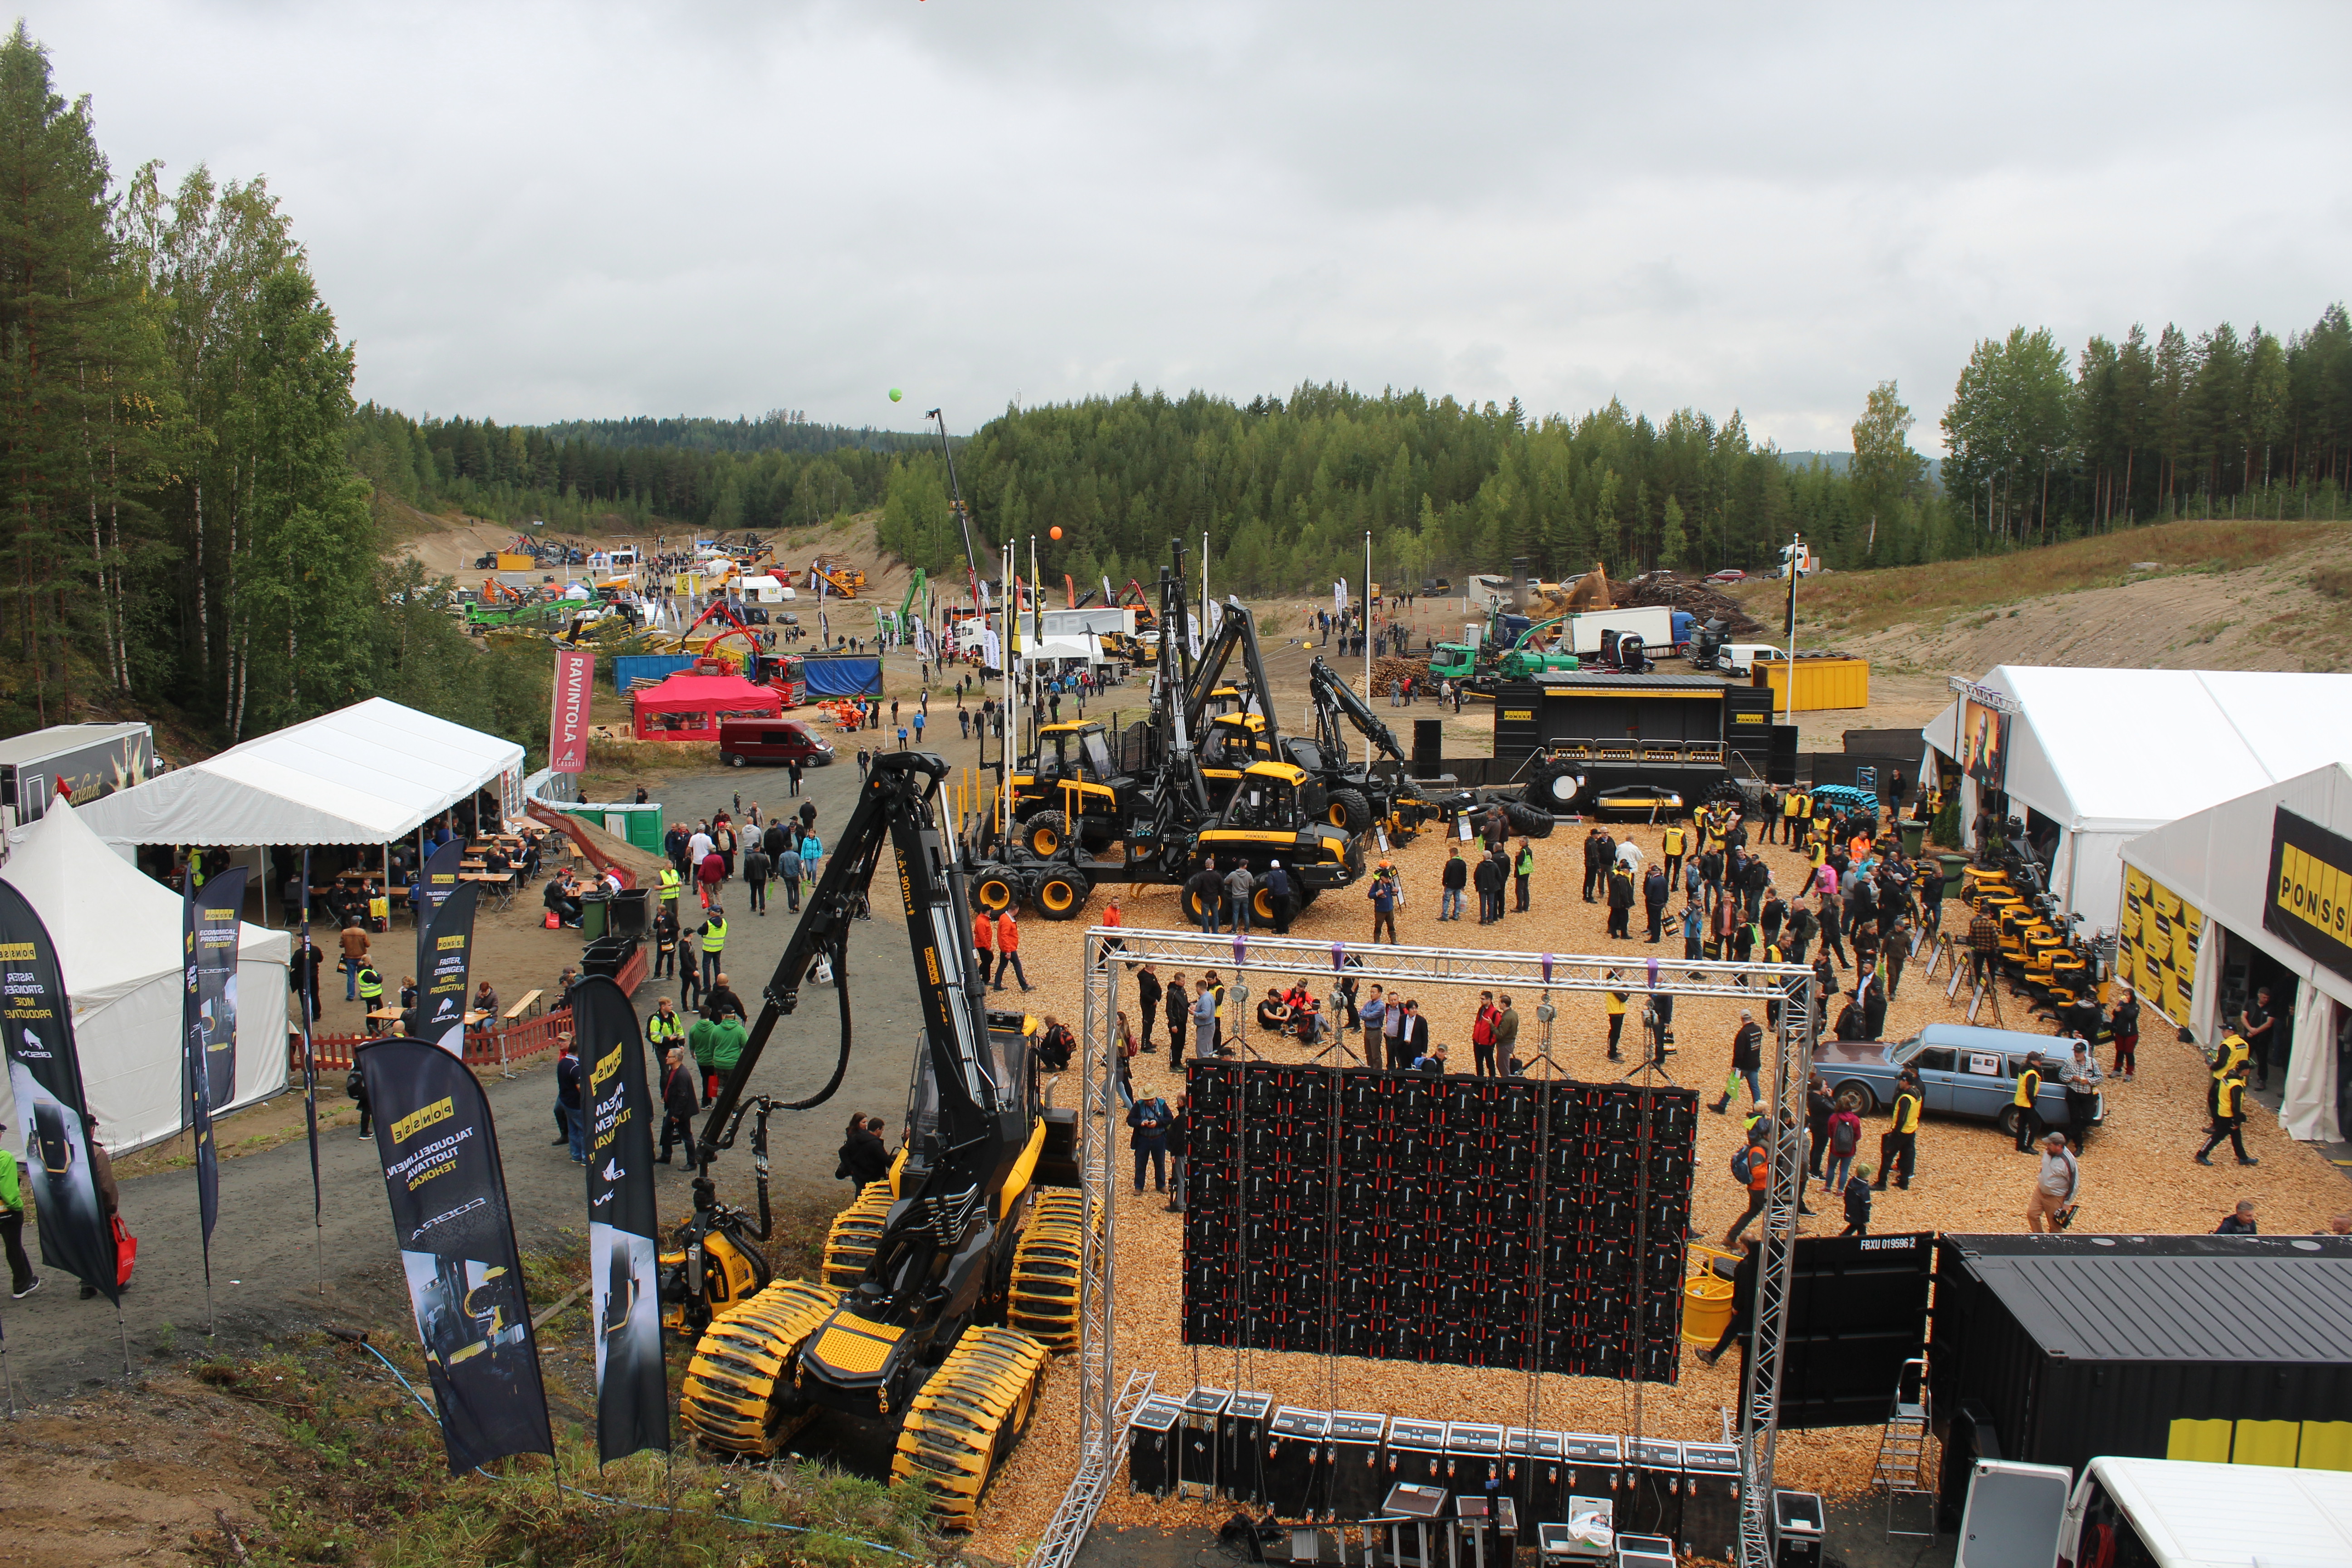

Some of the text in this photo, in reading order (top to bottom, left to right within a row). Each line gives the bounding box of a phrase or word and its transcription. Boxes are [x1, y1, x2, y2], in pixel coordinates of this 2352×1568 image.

[564, 658, 583, 743] RAVINTOLA
[52, 772, 103, 807] eixenet
[901, 876, 911, 902] 90m
[2281, 876, 2352, 937] PONSS
[439, 956, 461, 965] FASTER,
[926, 948, 936, 984] PONSSE
[440, 975, 457, 984] MORE
[1861, 1237, 1916, 1250] FBXU 019596 2
